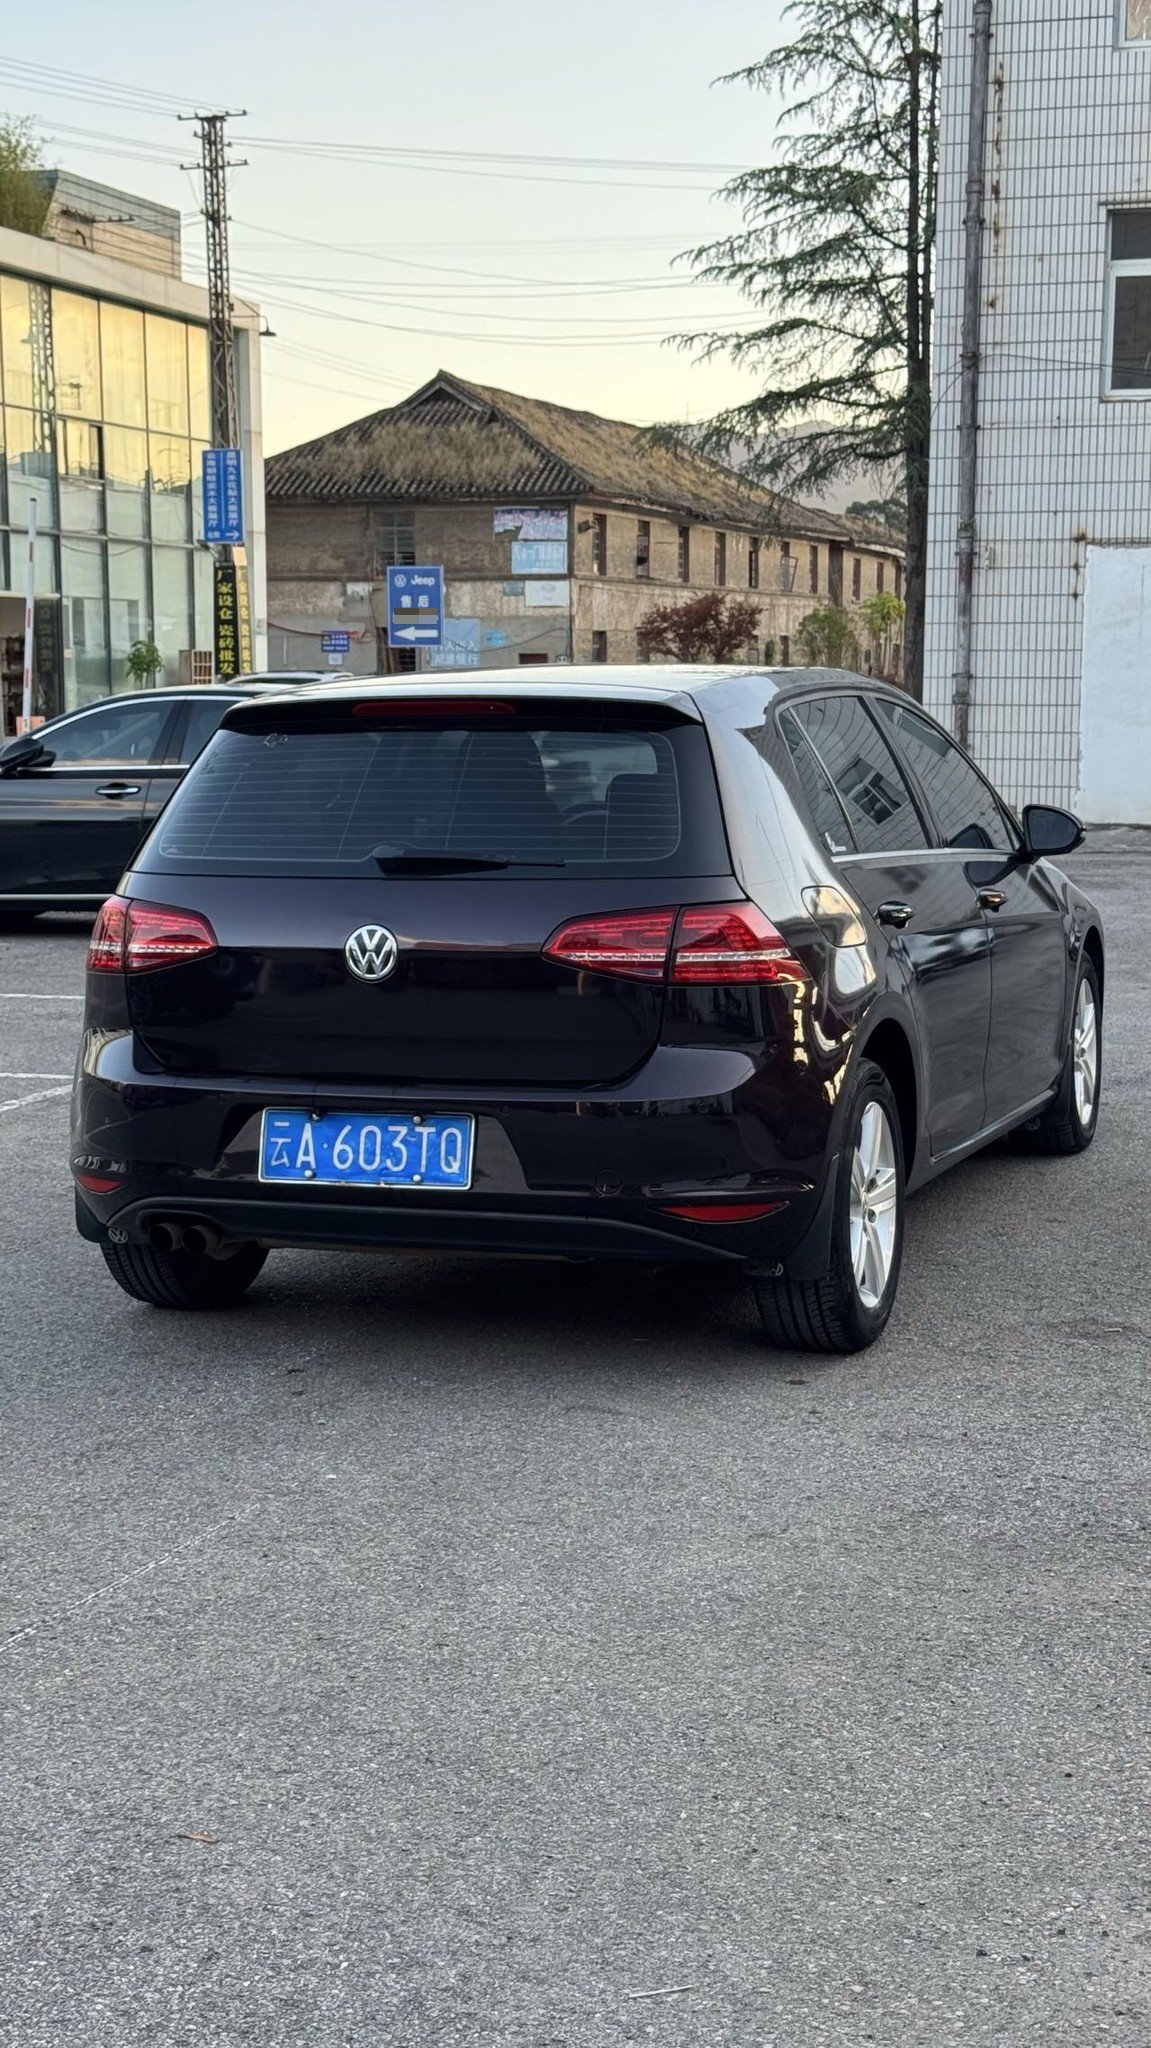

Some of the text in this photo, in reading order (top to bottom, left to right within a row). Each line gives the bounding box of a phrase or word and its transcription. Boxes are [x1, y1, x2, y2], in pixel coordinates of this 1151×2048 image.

[217, 569, 233, 619] 厂家设仓
[400, 594, 430, 609] 售后
[410, 575, 436, 587] Jeep
[218, 624, 235, 675] 瓷砖批发
[269, 1121, 463, 1175] 云A·603TQ
